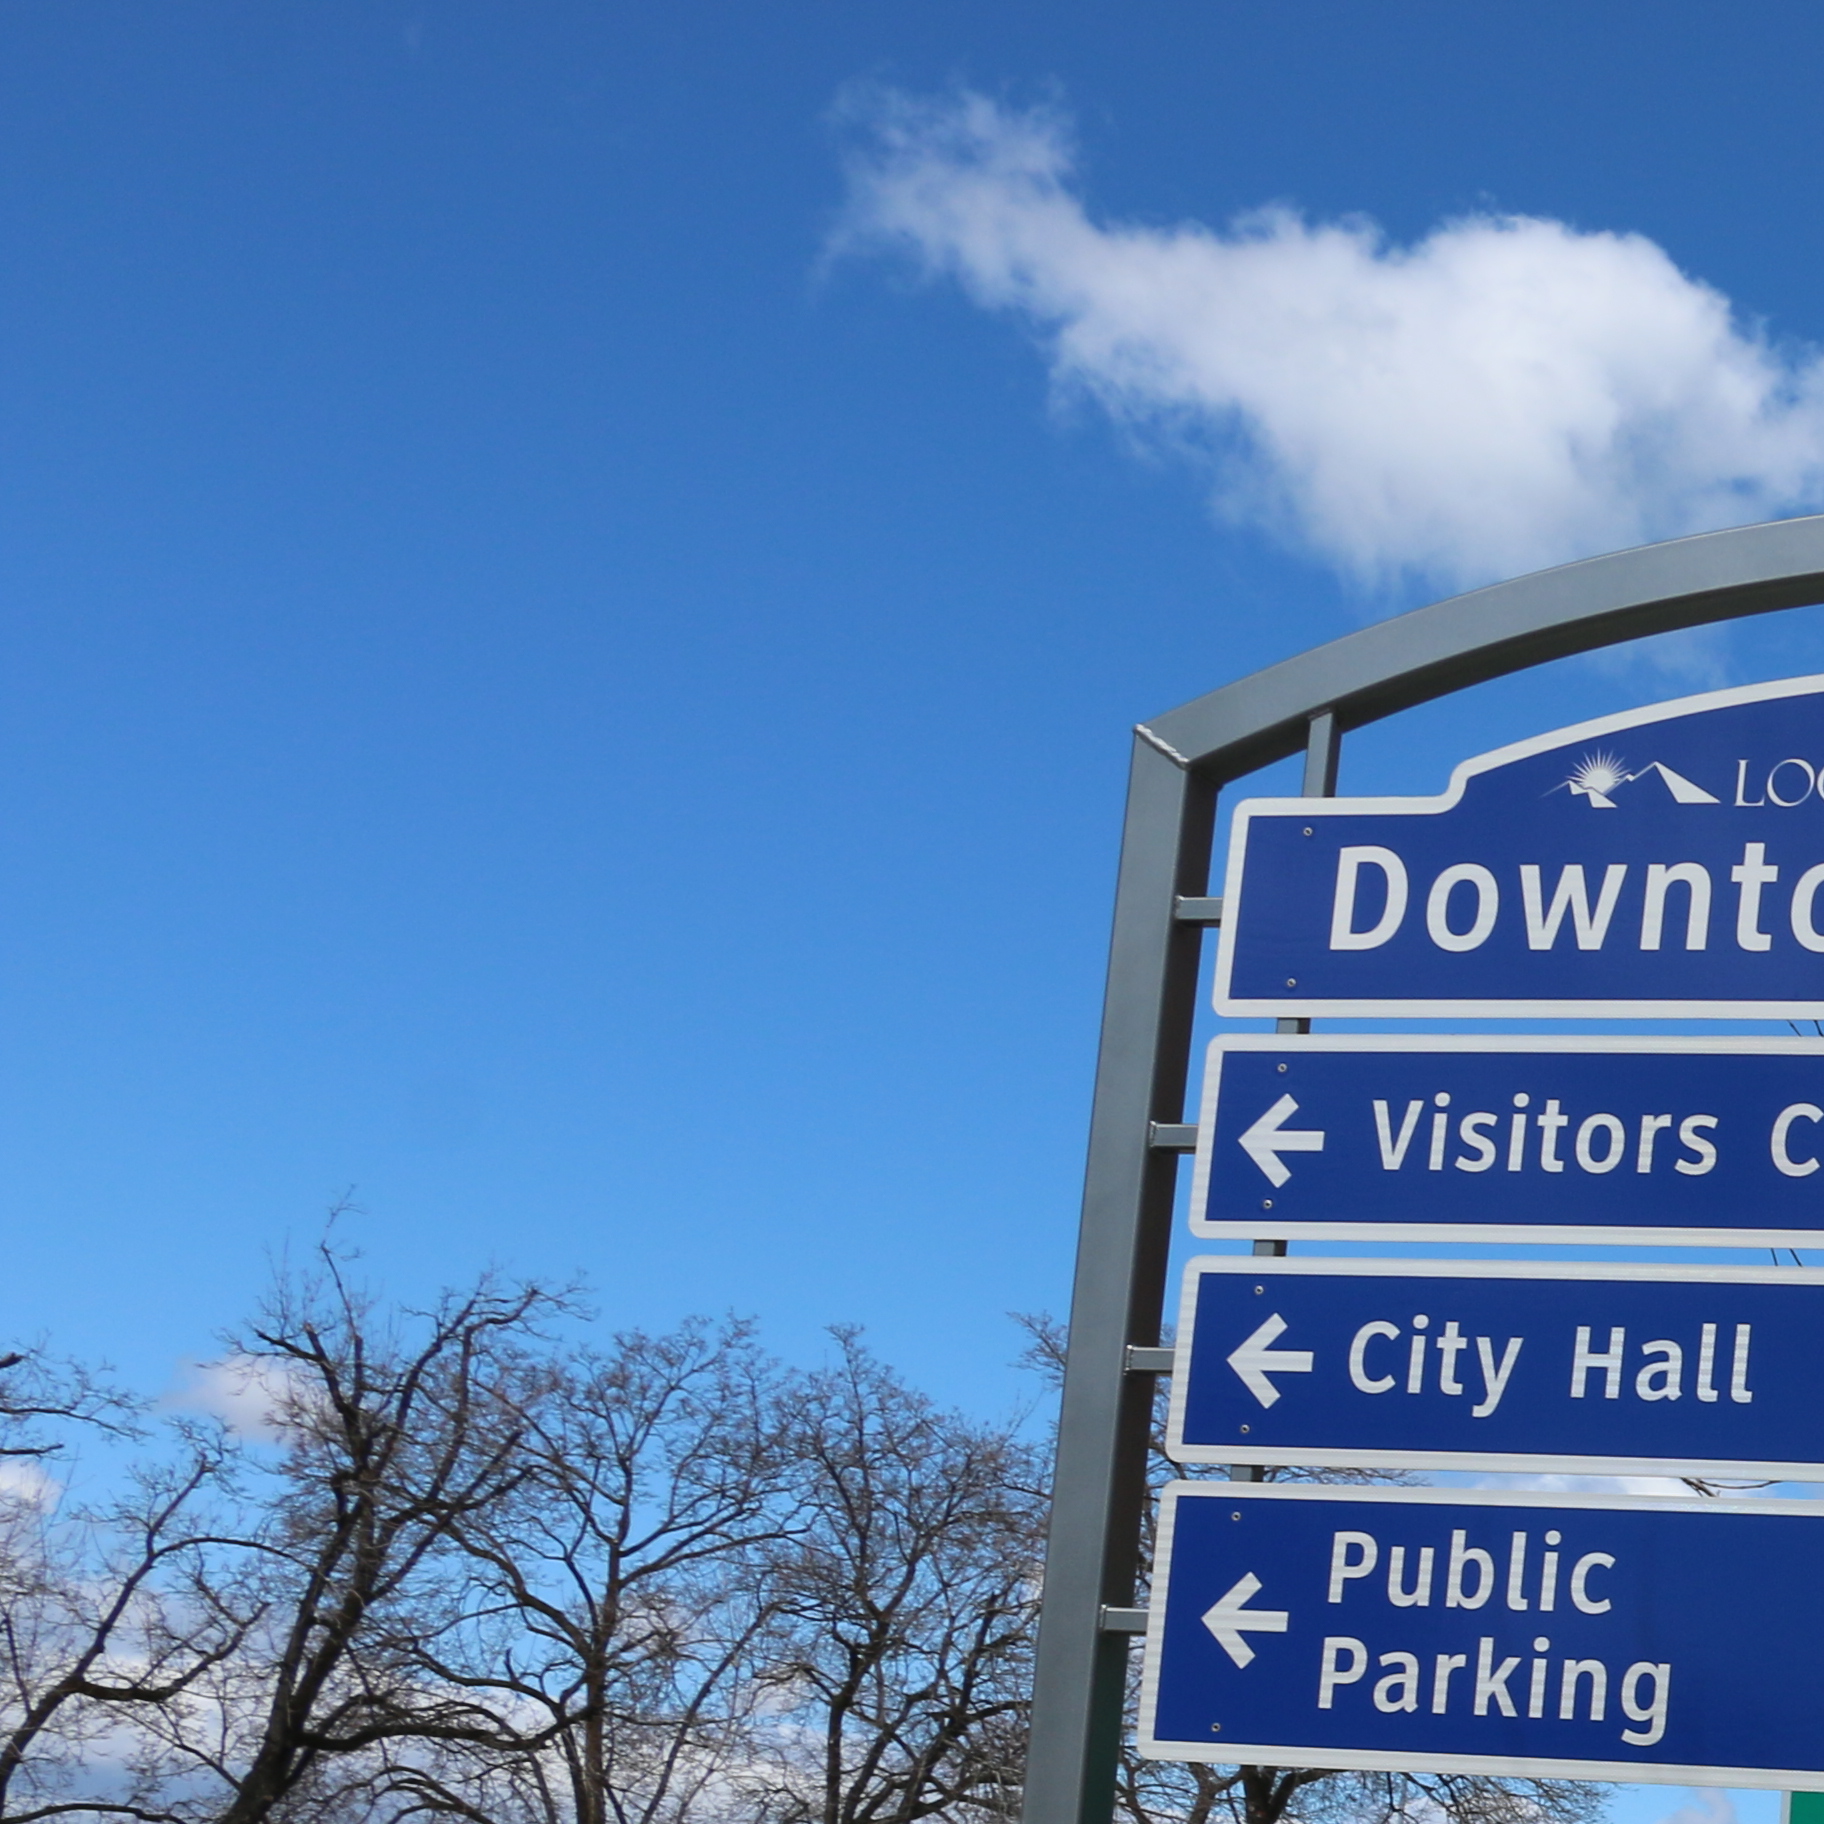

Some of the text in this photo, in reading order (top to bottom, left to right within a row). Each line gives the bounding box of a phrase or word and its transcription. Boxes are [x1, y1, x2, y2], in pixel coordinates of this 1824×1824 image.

[1371, 1091, 1719, 1177] Visitors
[1347, 1313, 1754, 1419] City Hall
[1326, 1528, 1617, 1616] Public
[1315, 1635, 1672, 1747] Parking
